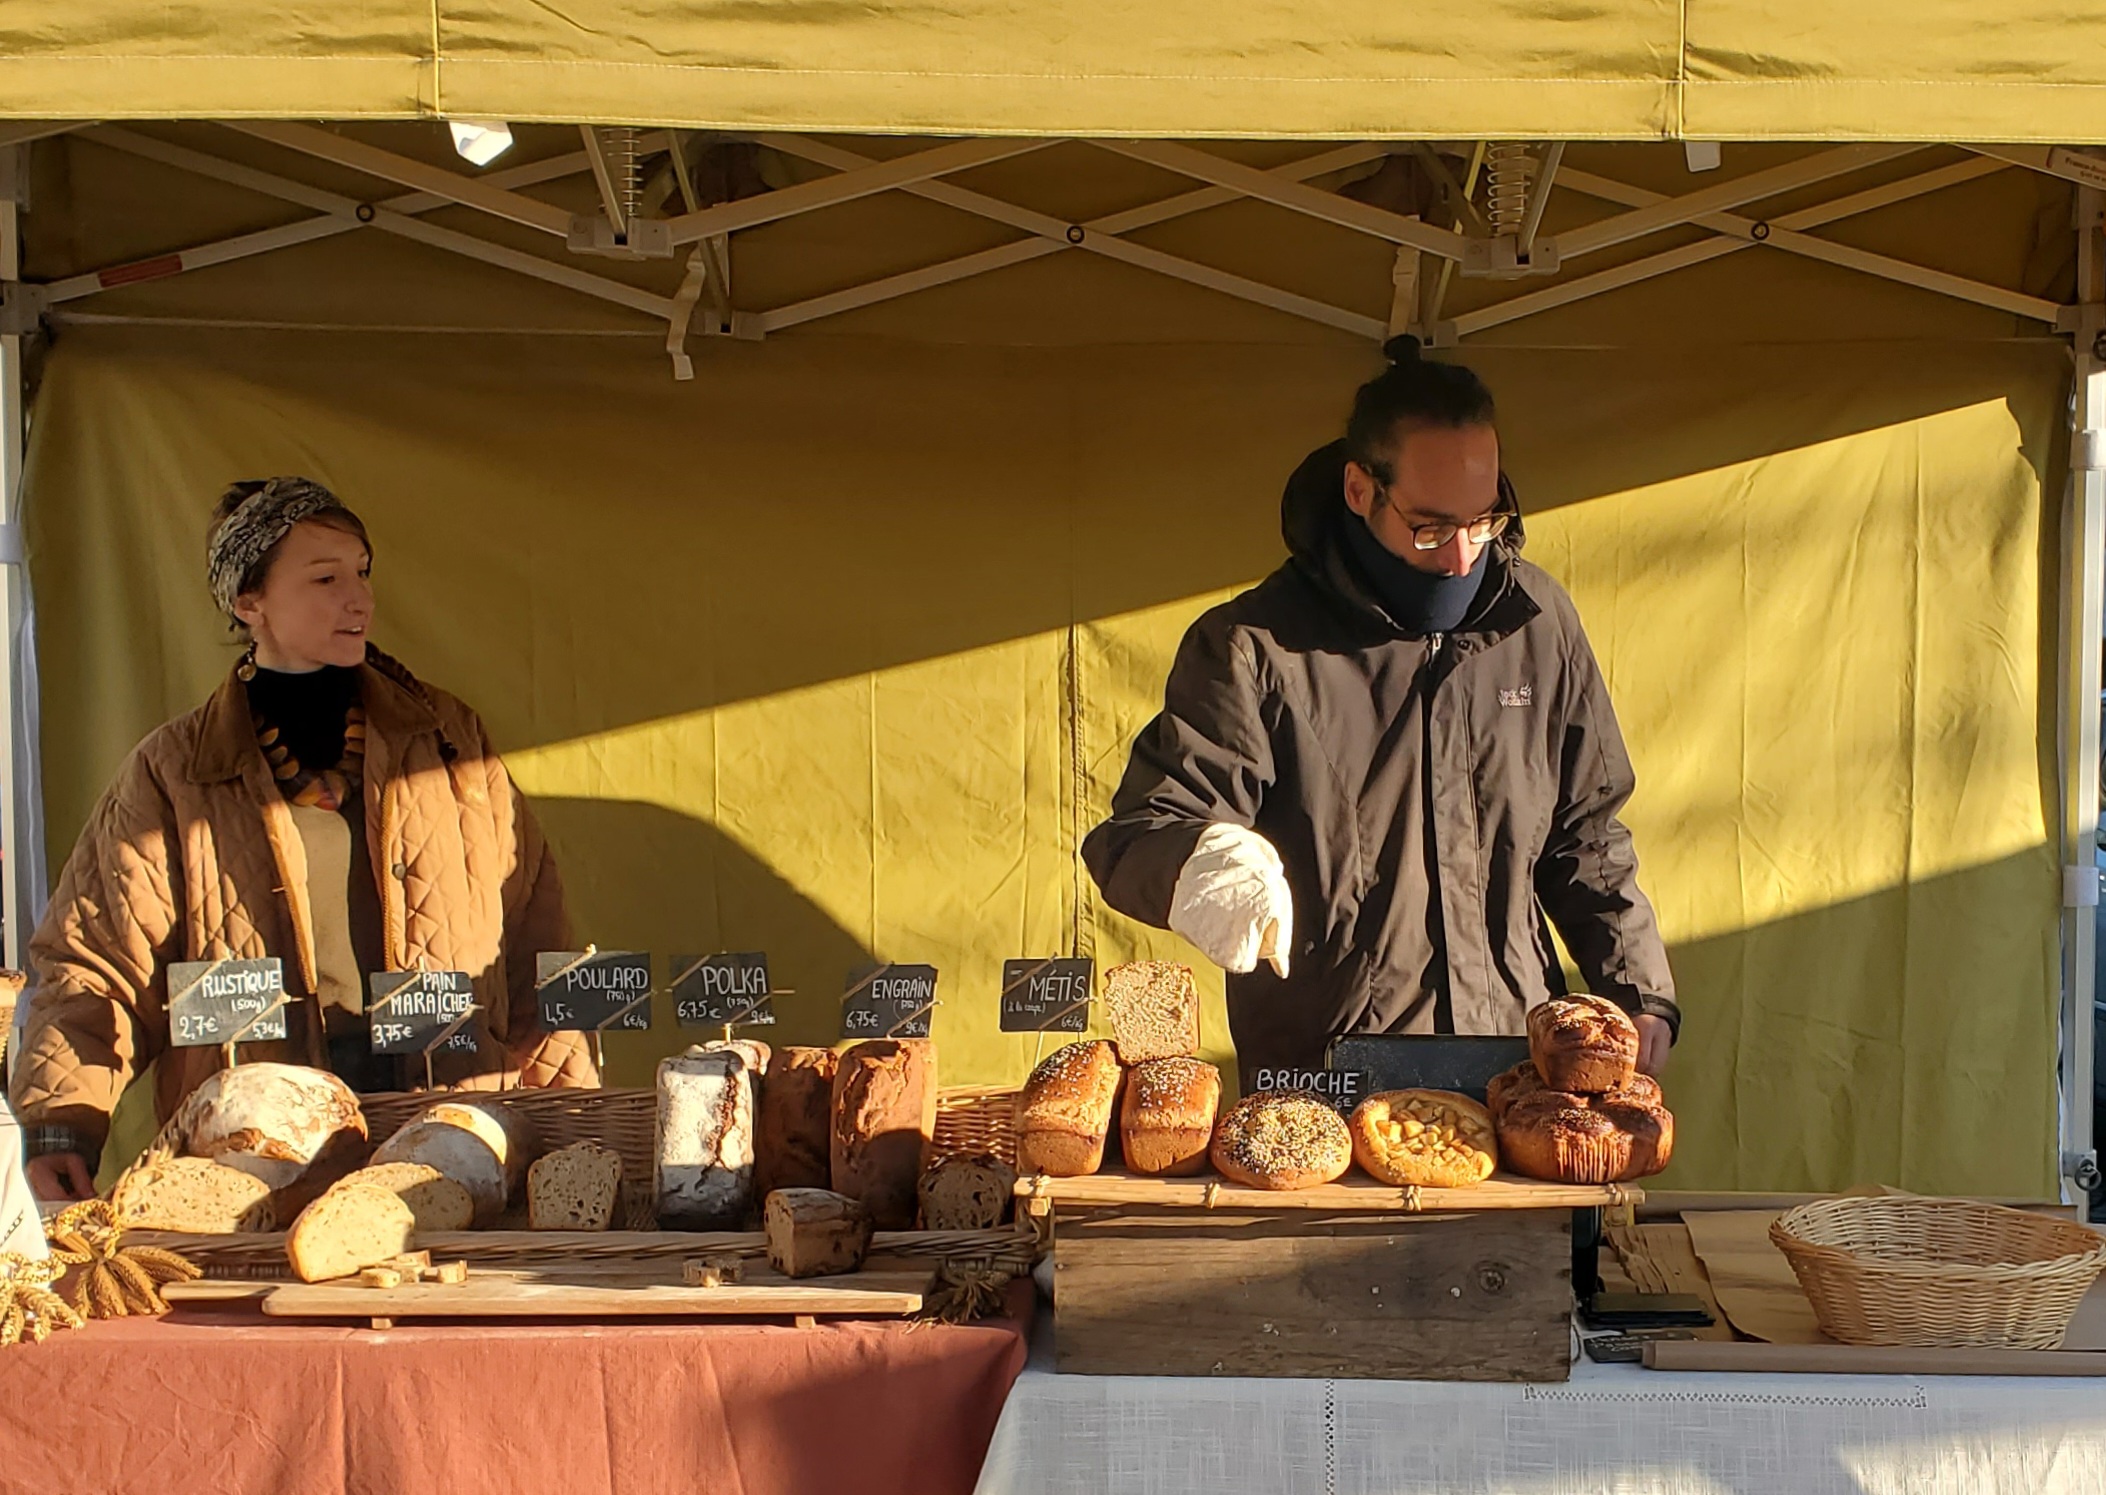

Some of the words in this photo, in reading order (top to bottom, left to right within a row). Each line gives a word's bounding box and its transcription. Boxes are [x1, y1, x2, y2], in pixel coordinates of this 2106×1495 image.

[565, 966, 649, 993] POULARD
[701, 965, 768, 996] POLKA
[677, 1000, 722, 1019] 6,75€
[845, 1010, 879, 1029] 6,75€
[179, 1015, 219, 1040] 2,7€
[372, 1023, 414, 1049] 3,75€
